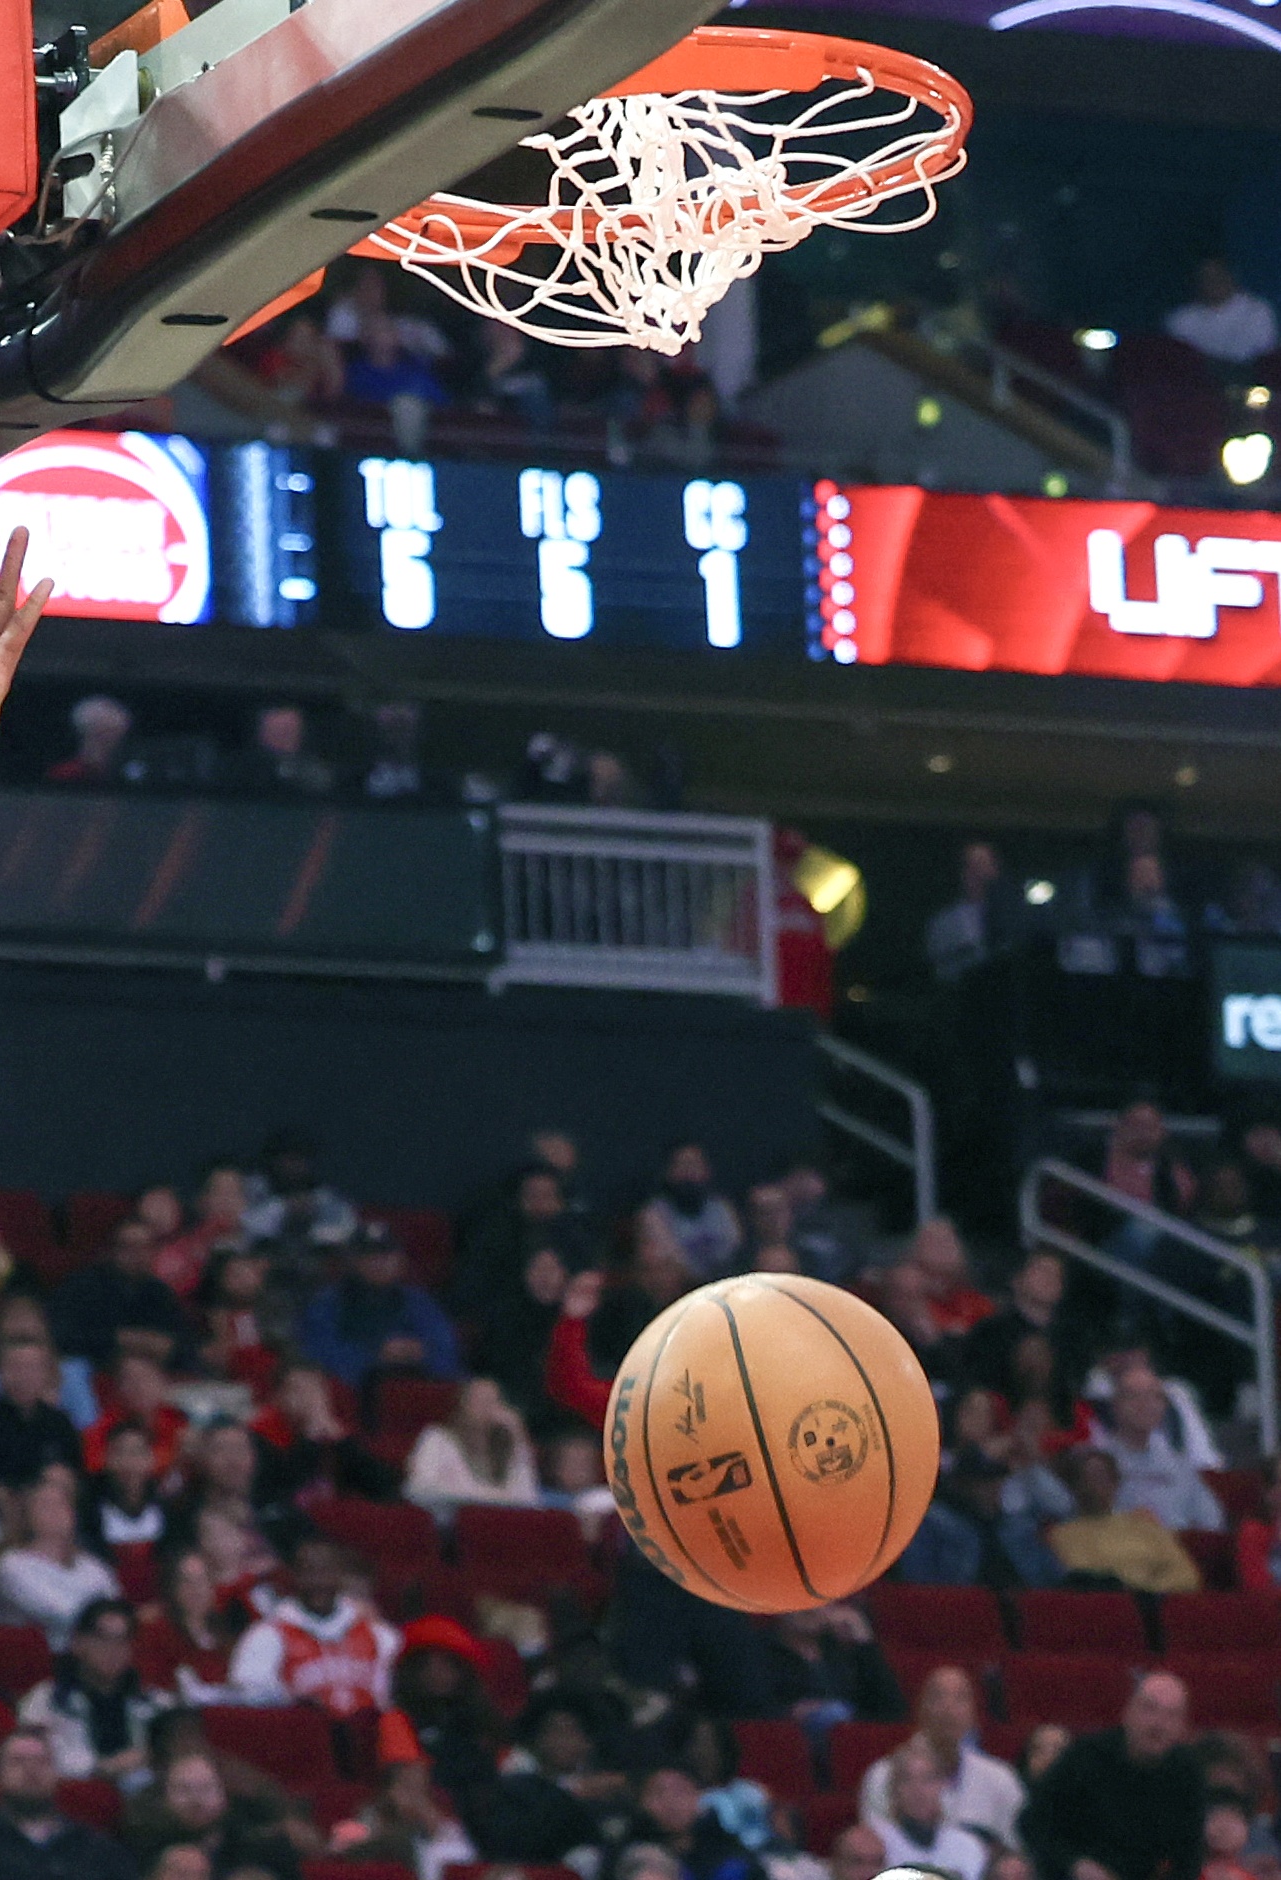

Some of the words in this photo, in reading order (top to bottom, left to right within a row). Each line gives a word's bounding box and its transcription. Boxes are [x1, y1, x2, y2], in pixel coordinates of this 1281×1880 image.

[358, 457, 444, 532] TOL
[518, 467, 602, 542] FLS
[698, 548, 742, 648] 1
